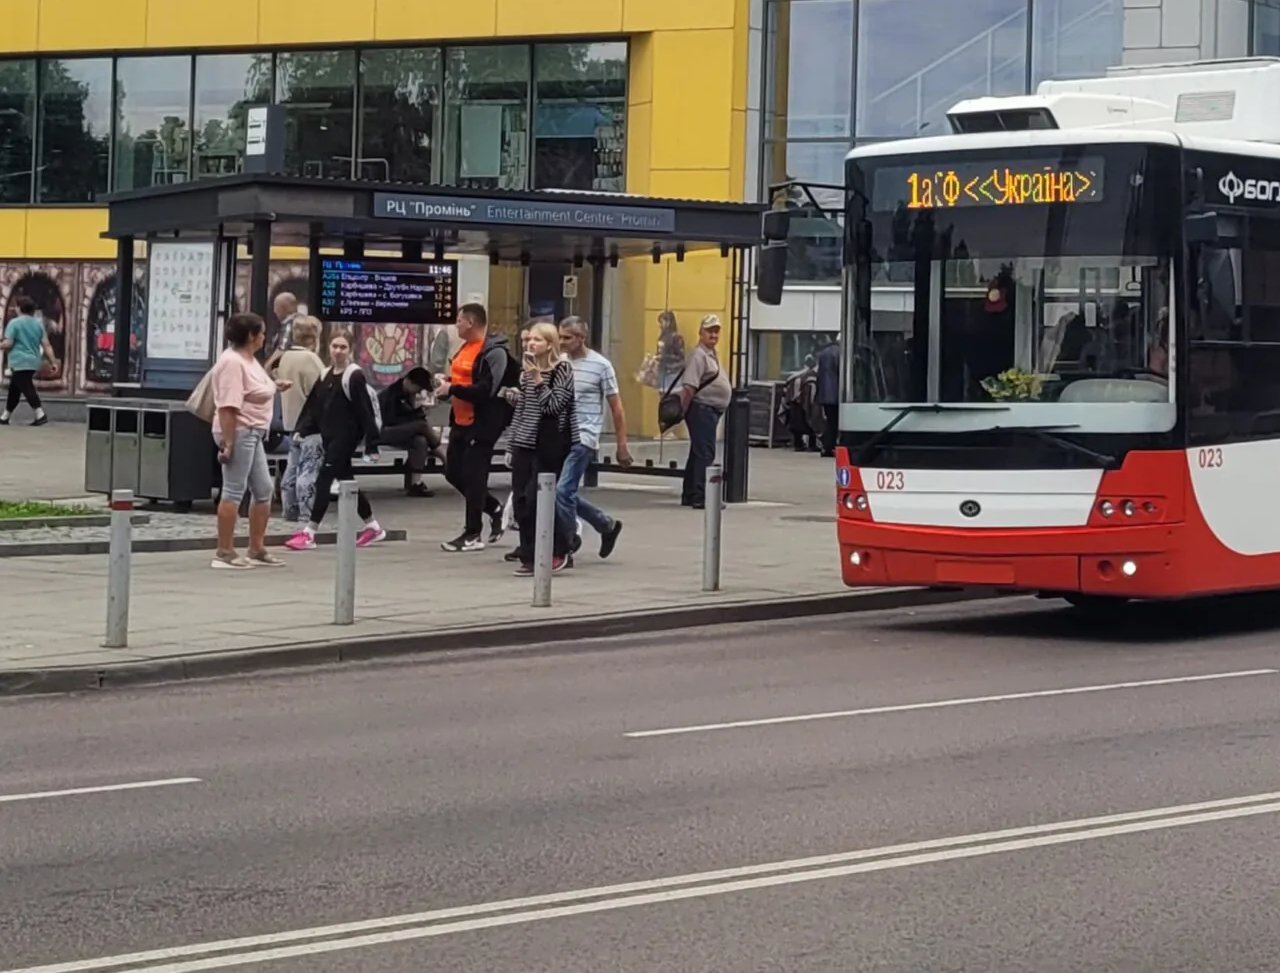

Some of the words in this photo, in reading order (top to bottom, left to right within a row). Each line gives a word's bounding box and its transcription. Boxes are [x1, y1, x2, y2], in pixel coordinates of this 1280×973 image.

[386, 200, 406, 216] РЦ
[409, 201, 476, 217] "Промінь"
[487, 205, 571, 223] Entertainment
[575, 209, 614, 224] Centre
[428, 265, 452, 274] 11:46
[1198, 447, 1224, 469] 023
[876, 470, 905, 491] 023
